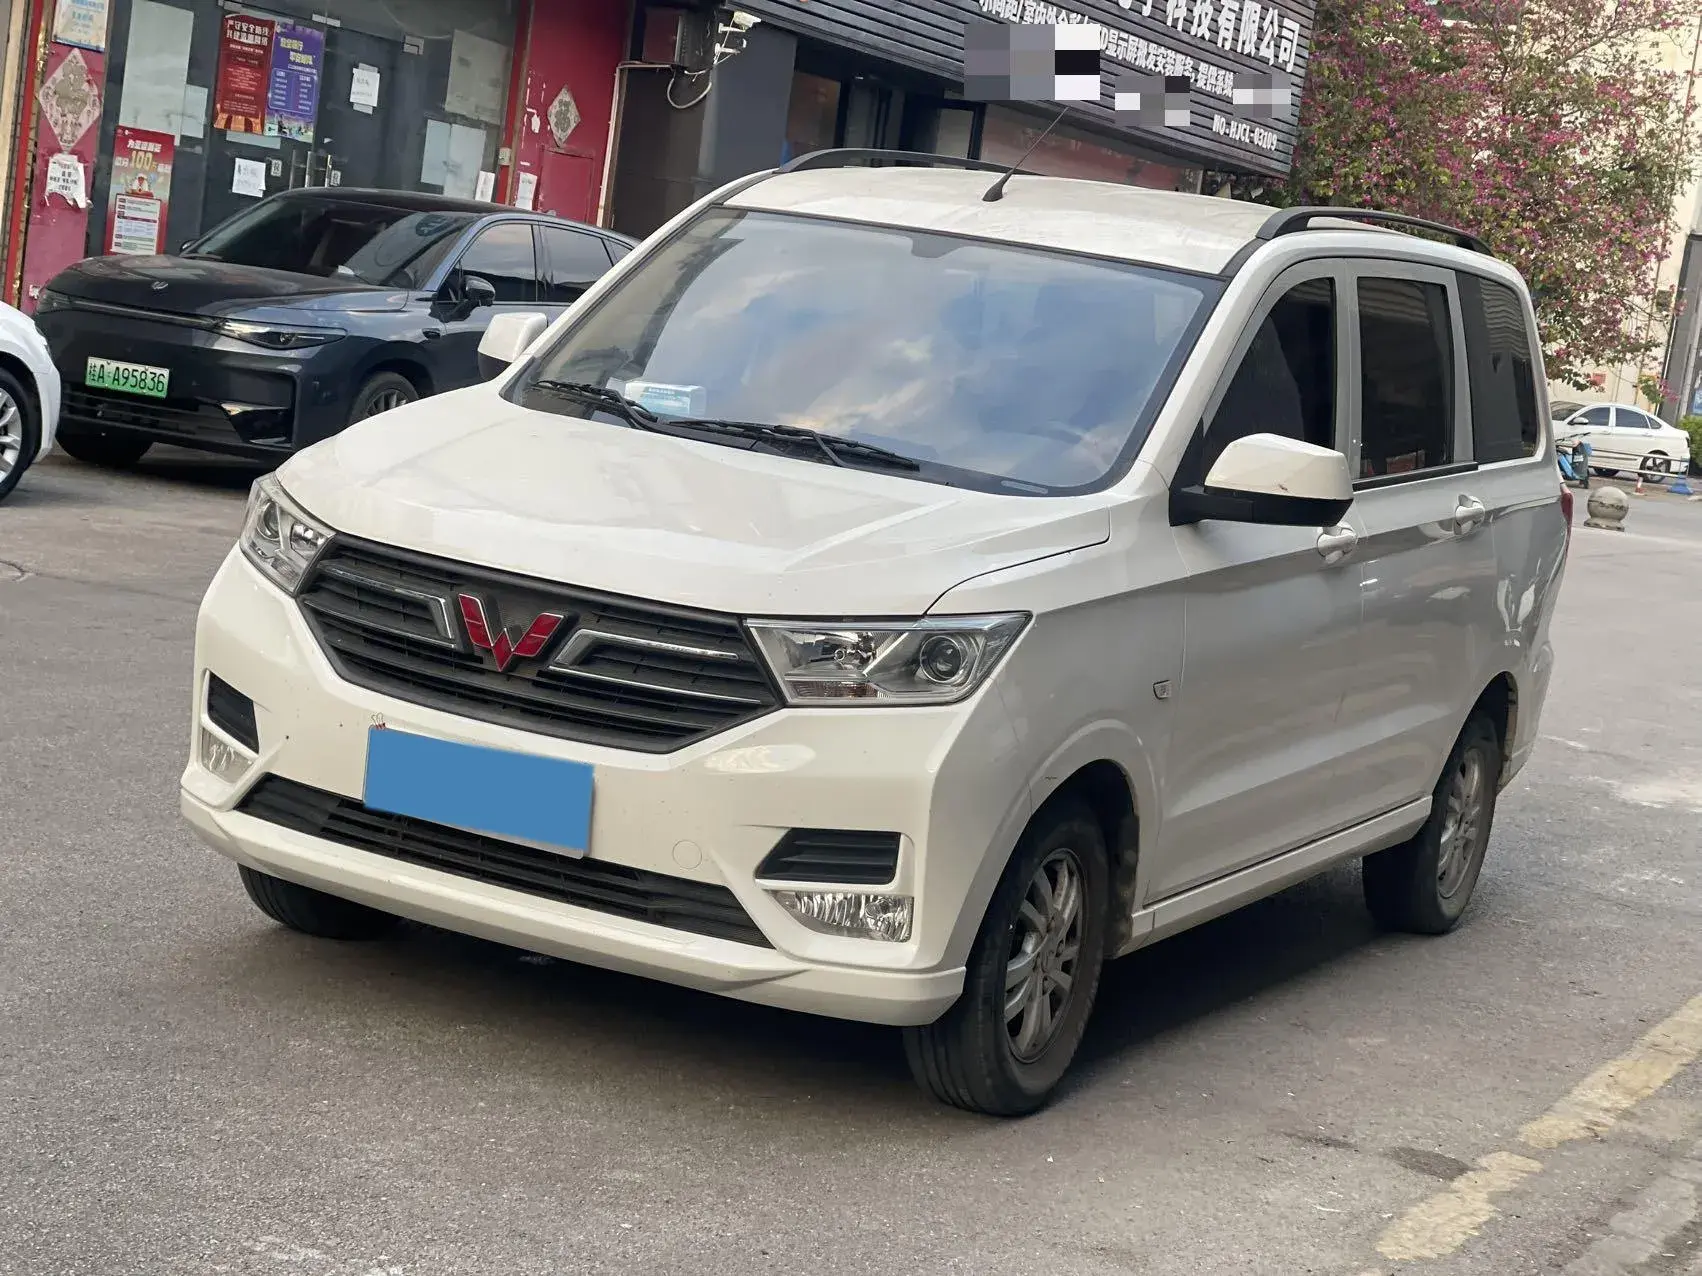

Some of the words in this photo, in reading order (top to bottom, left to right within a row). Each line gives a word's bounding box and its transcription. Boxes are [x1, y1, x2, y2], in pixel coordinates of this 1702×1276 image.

[1117, 0, 1300, 73] 科技有限公司
